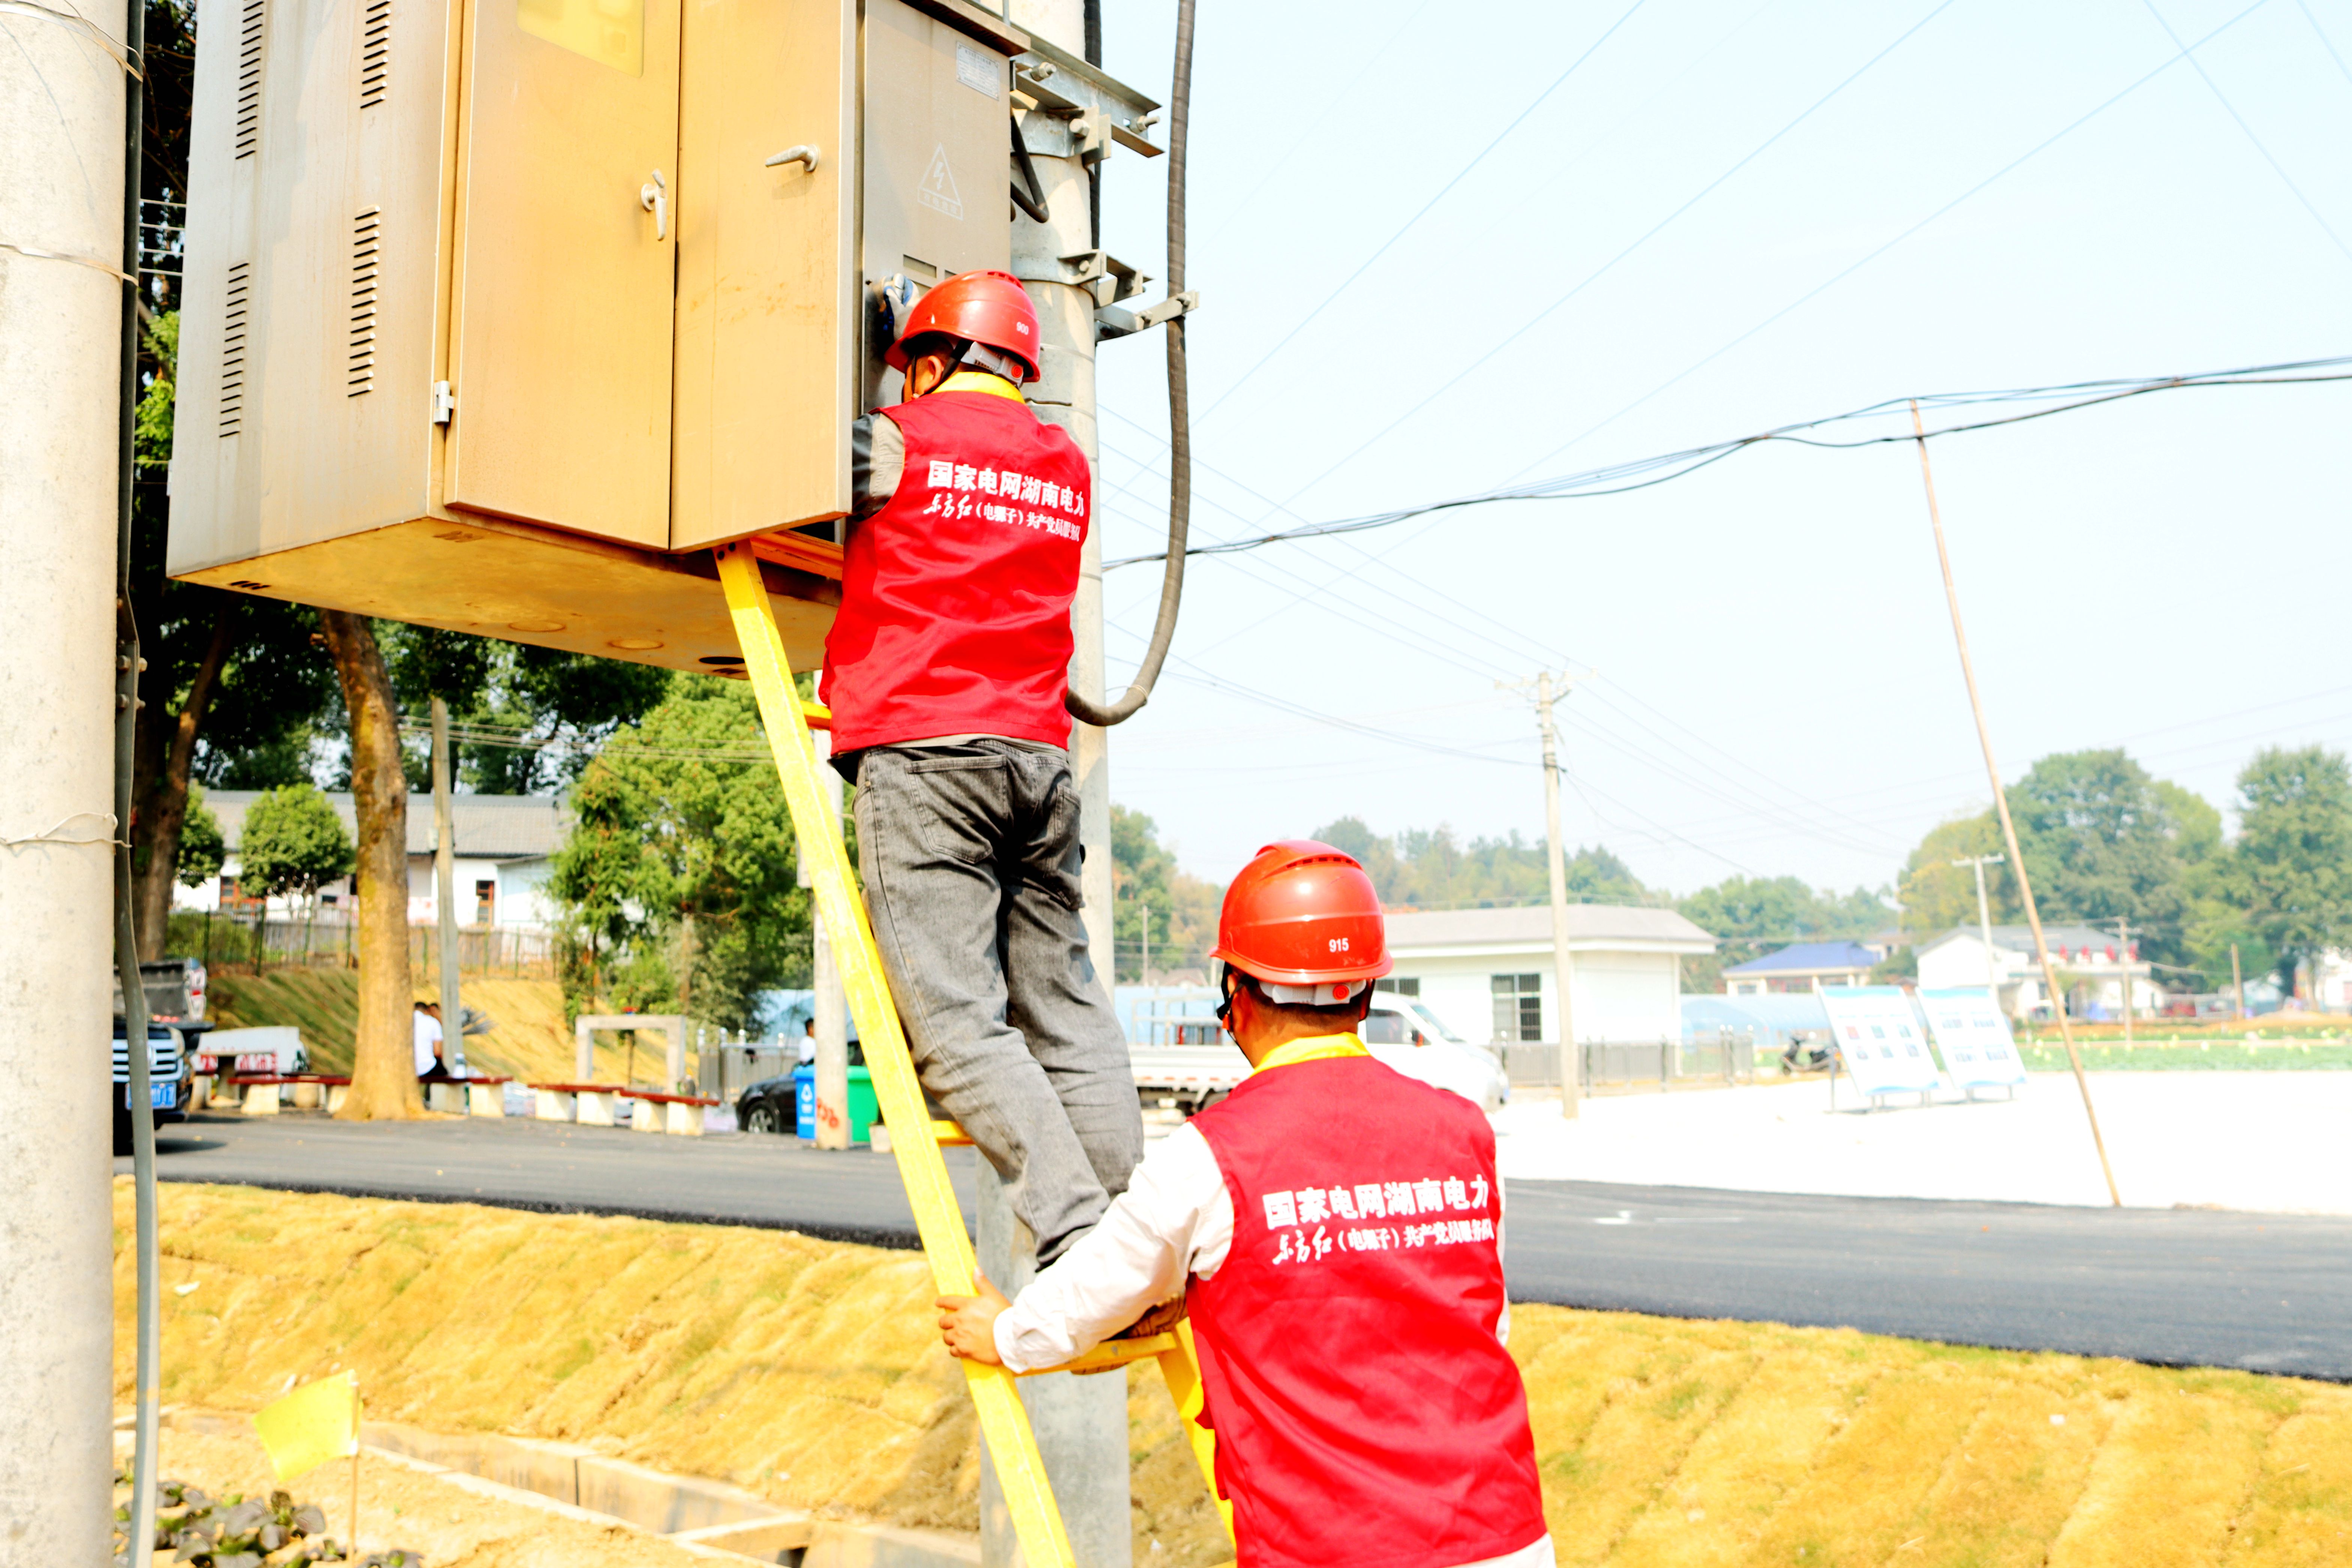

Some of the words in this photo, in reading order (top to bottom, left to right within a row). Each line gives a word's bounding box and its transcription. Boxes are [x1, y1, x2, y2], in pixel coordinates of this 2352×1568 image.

[927, 460, 1085, 517] 国家电网湖南电力
[1328, 938, 1349, 953] 915
[1262, 1174, 1488, 1230] 国家电网湖南电力
